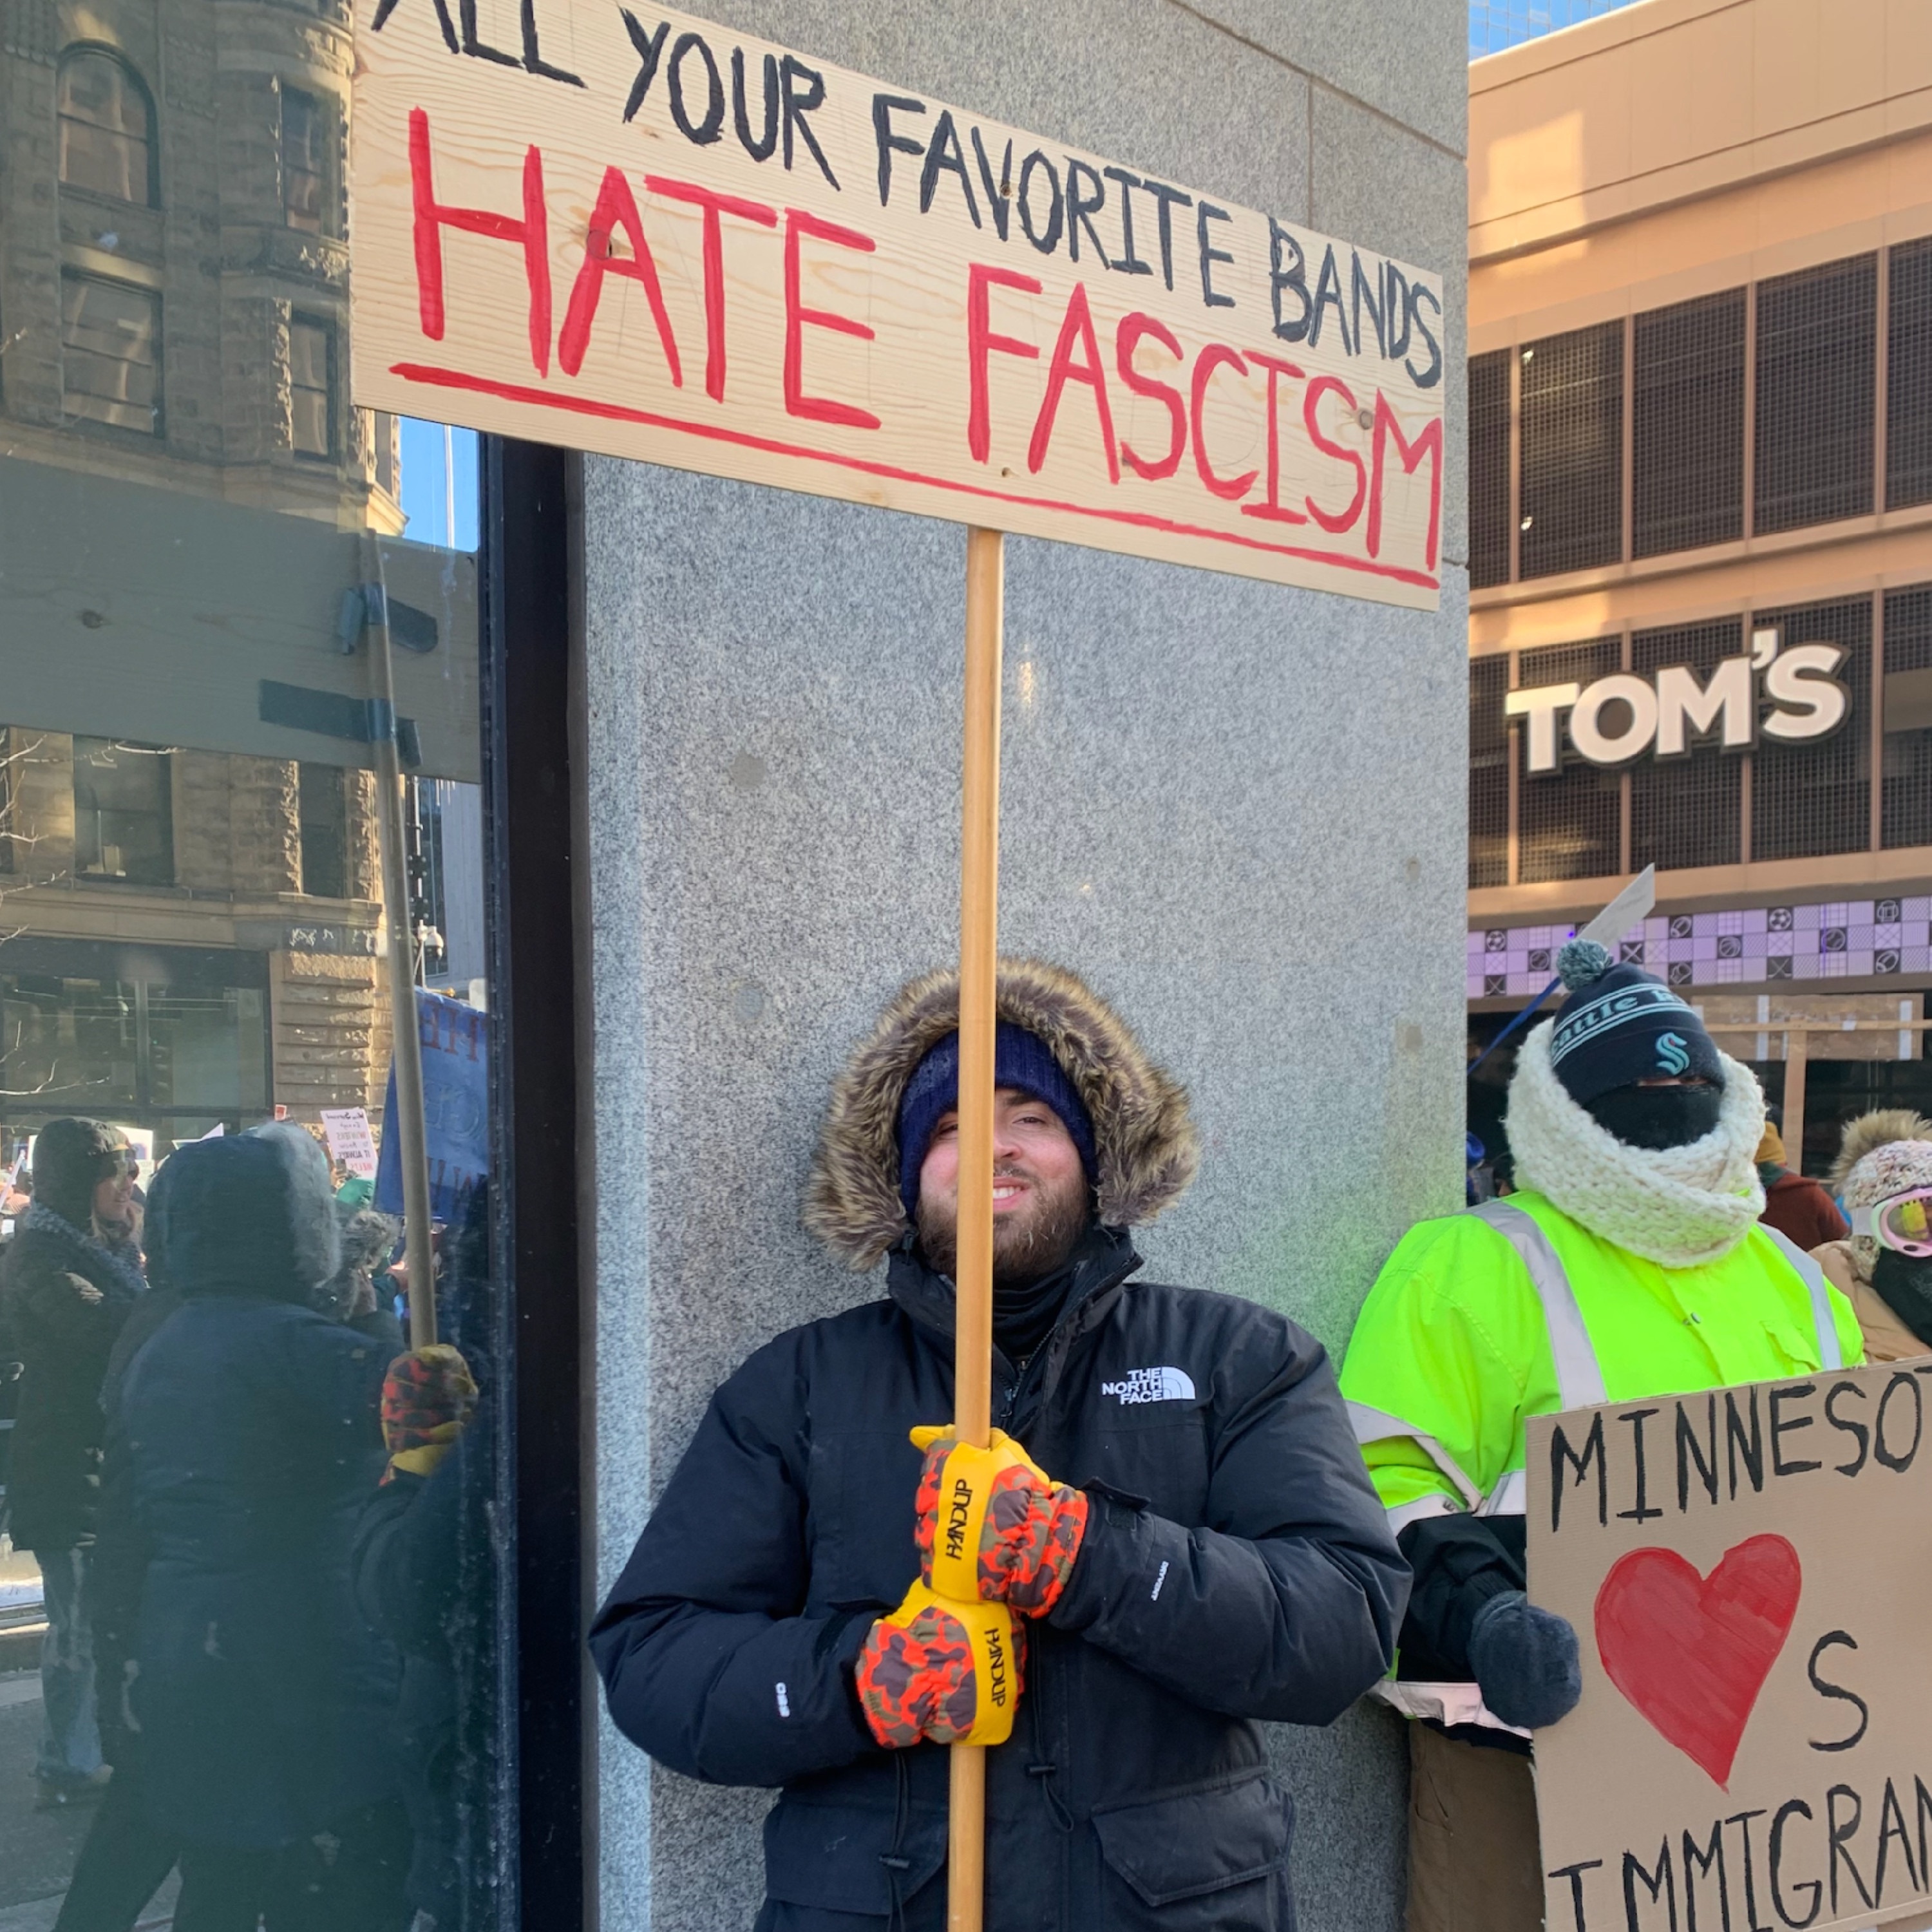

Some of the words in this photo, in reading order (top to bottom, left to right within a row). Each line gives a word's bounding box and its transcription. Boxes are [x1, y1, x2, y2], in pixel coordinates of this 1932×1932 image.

[617, 1, 841, 192] YOUR
[873, 93, 1236, 307] FAVORITE
[1267, 212, 1443, 389] BANDS
[408, 104, 882, 430] HATE
[967, 262, 1443, 572] FASCISM
[1505, 629, 1846, 773] TOM'S
[1102, 1378, 1162, 1395] NORTH
[1120, 1389, 1163, 1405] FACE
[1127, 1367, 1162, 1381] THE
[1551, 1365, 1932, 1533] MINNESO
[945, 1479, 973, 1560] HANDUP
[984, 1627, 1006, 1707] HANDUP
[1808, 1630, 1869, 1752] S
